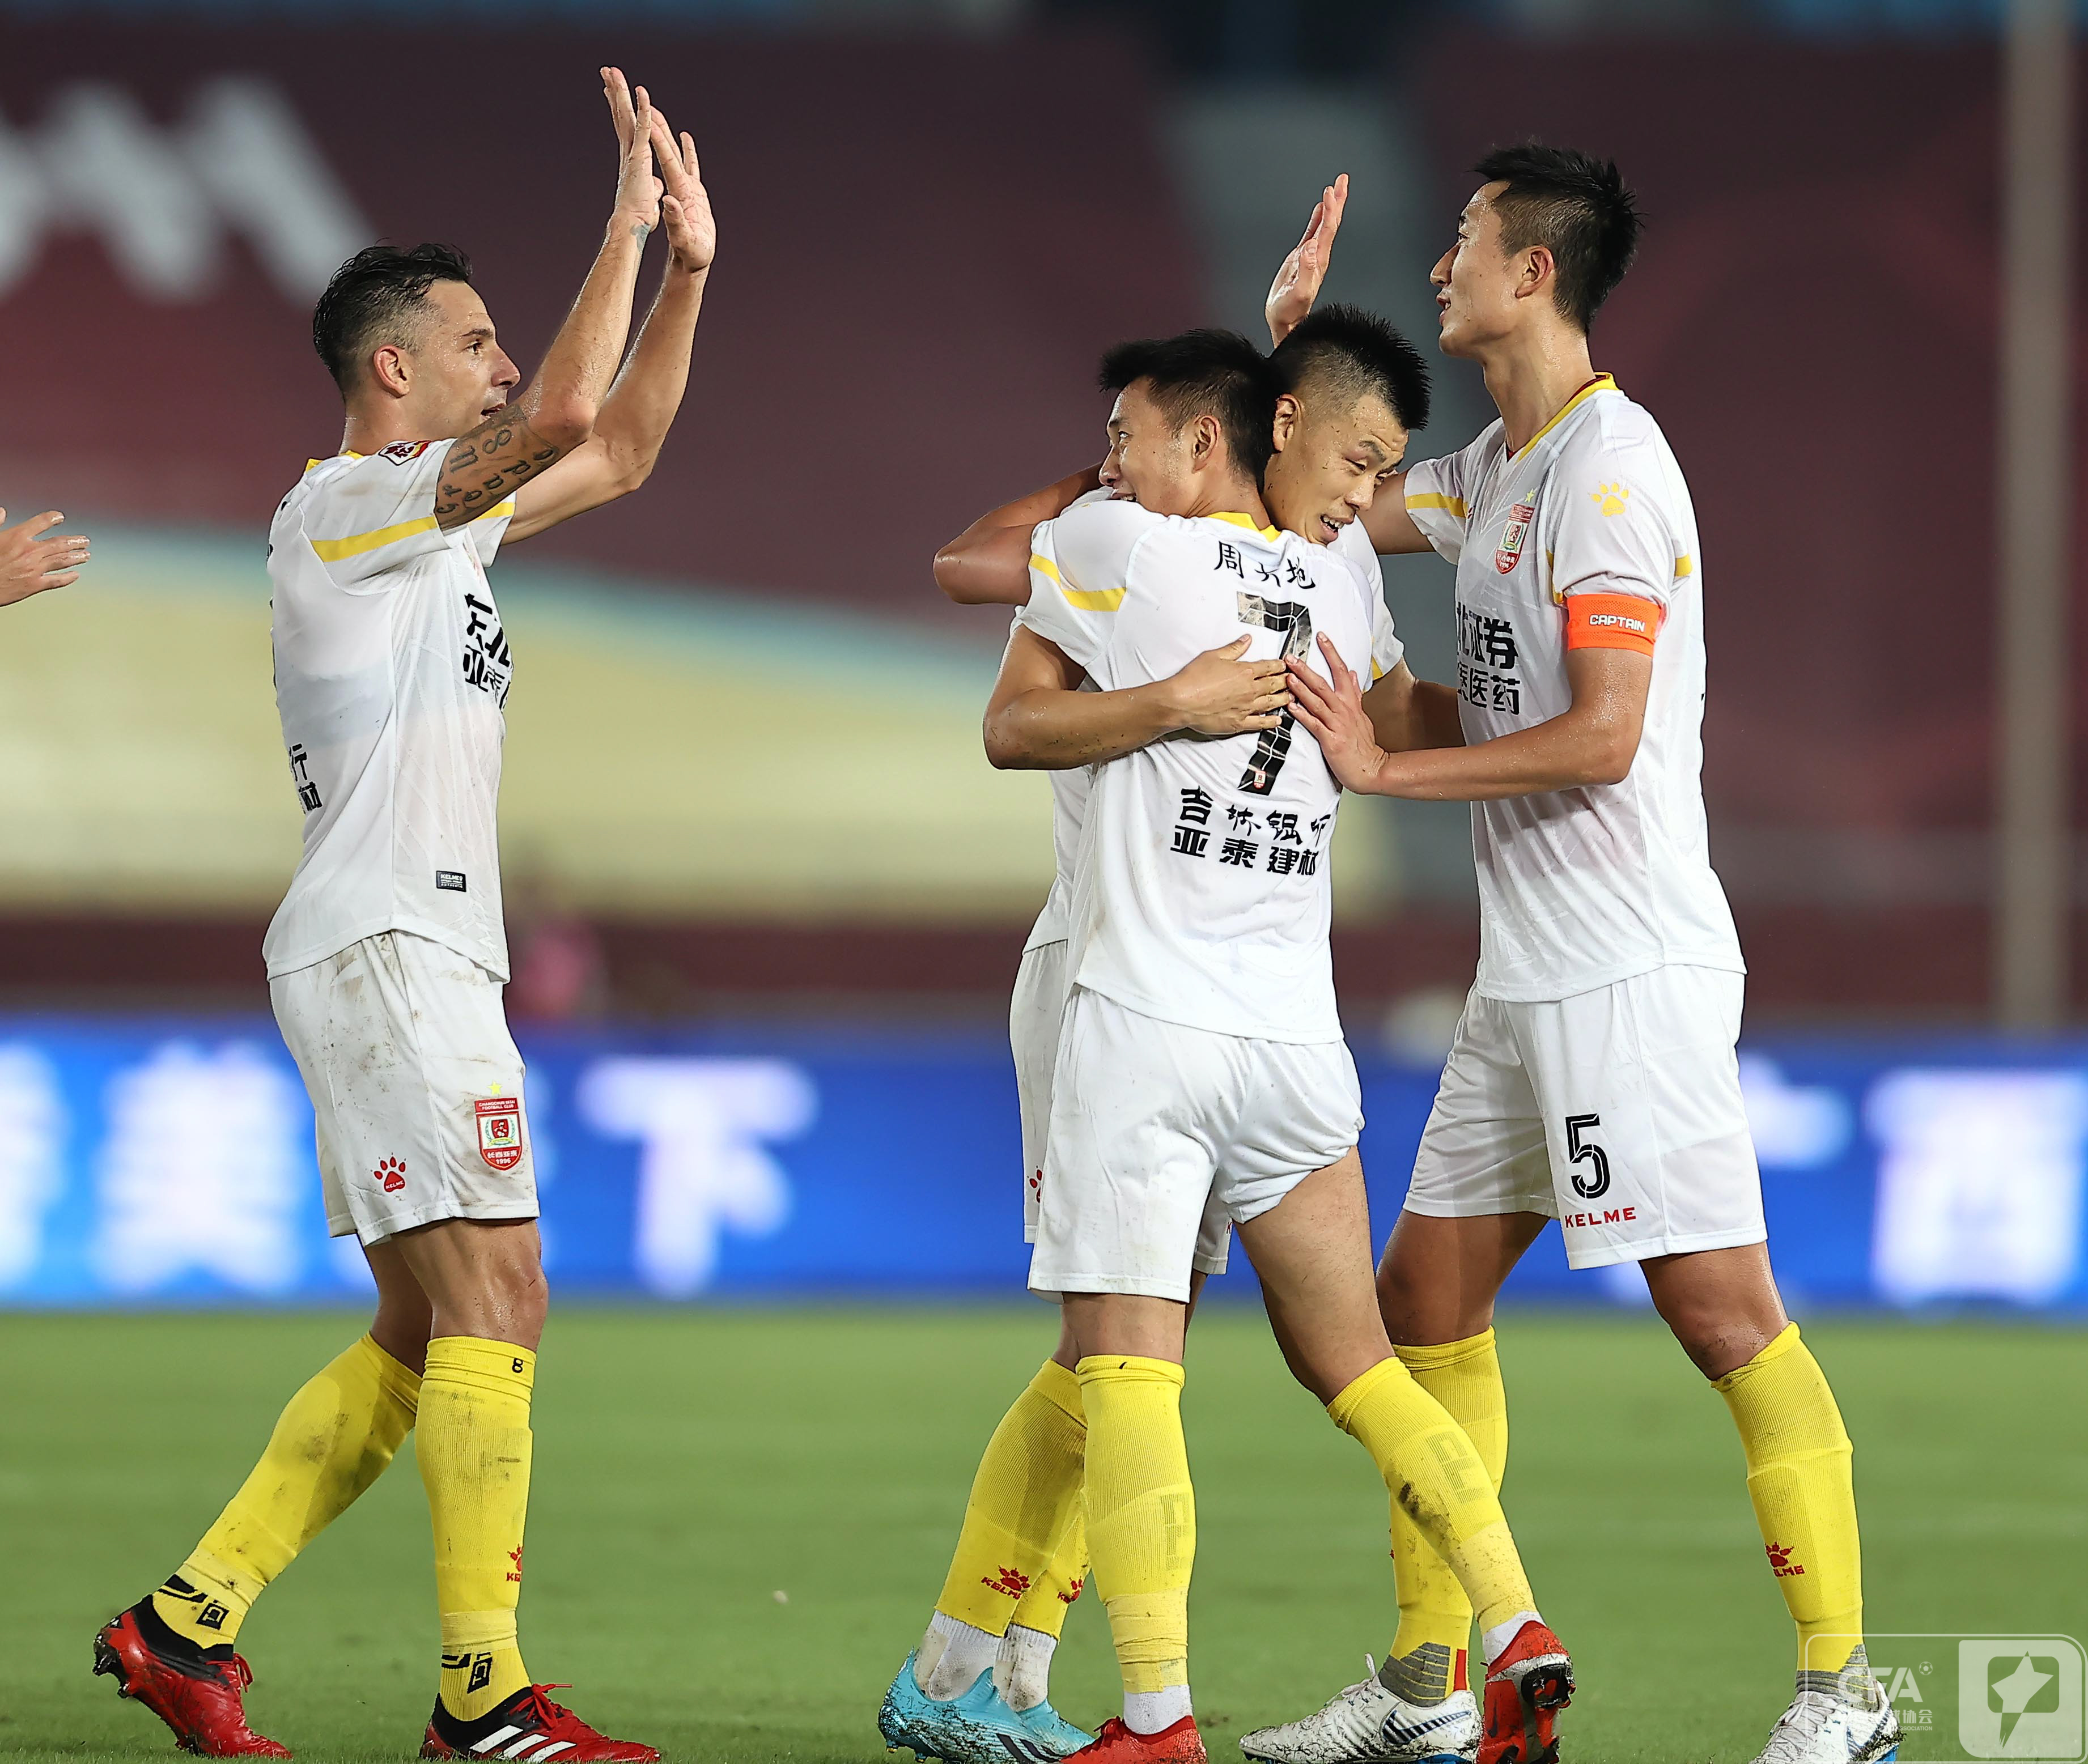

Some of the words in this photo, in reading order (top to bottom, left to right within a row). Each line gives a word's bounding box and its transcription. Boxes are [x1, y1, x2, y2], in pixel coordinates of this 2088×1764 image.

[1214, 541, 1315, 589] 周大地
[1589, 614, 1645, 633] CAPTAIN
[1237, 591, 1312, 796] 7
[1565, 1113, 1610, 1199] 5
[1564, 1206, 1636, 1229] KELME
[512, 1358, 524, 1374] 8
